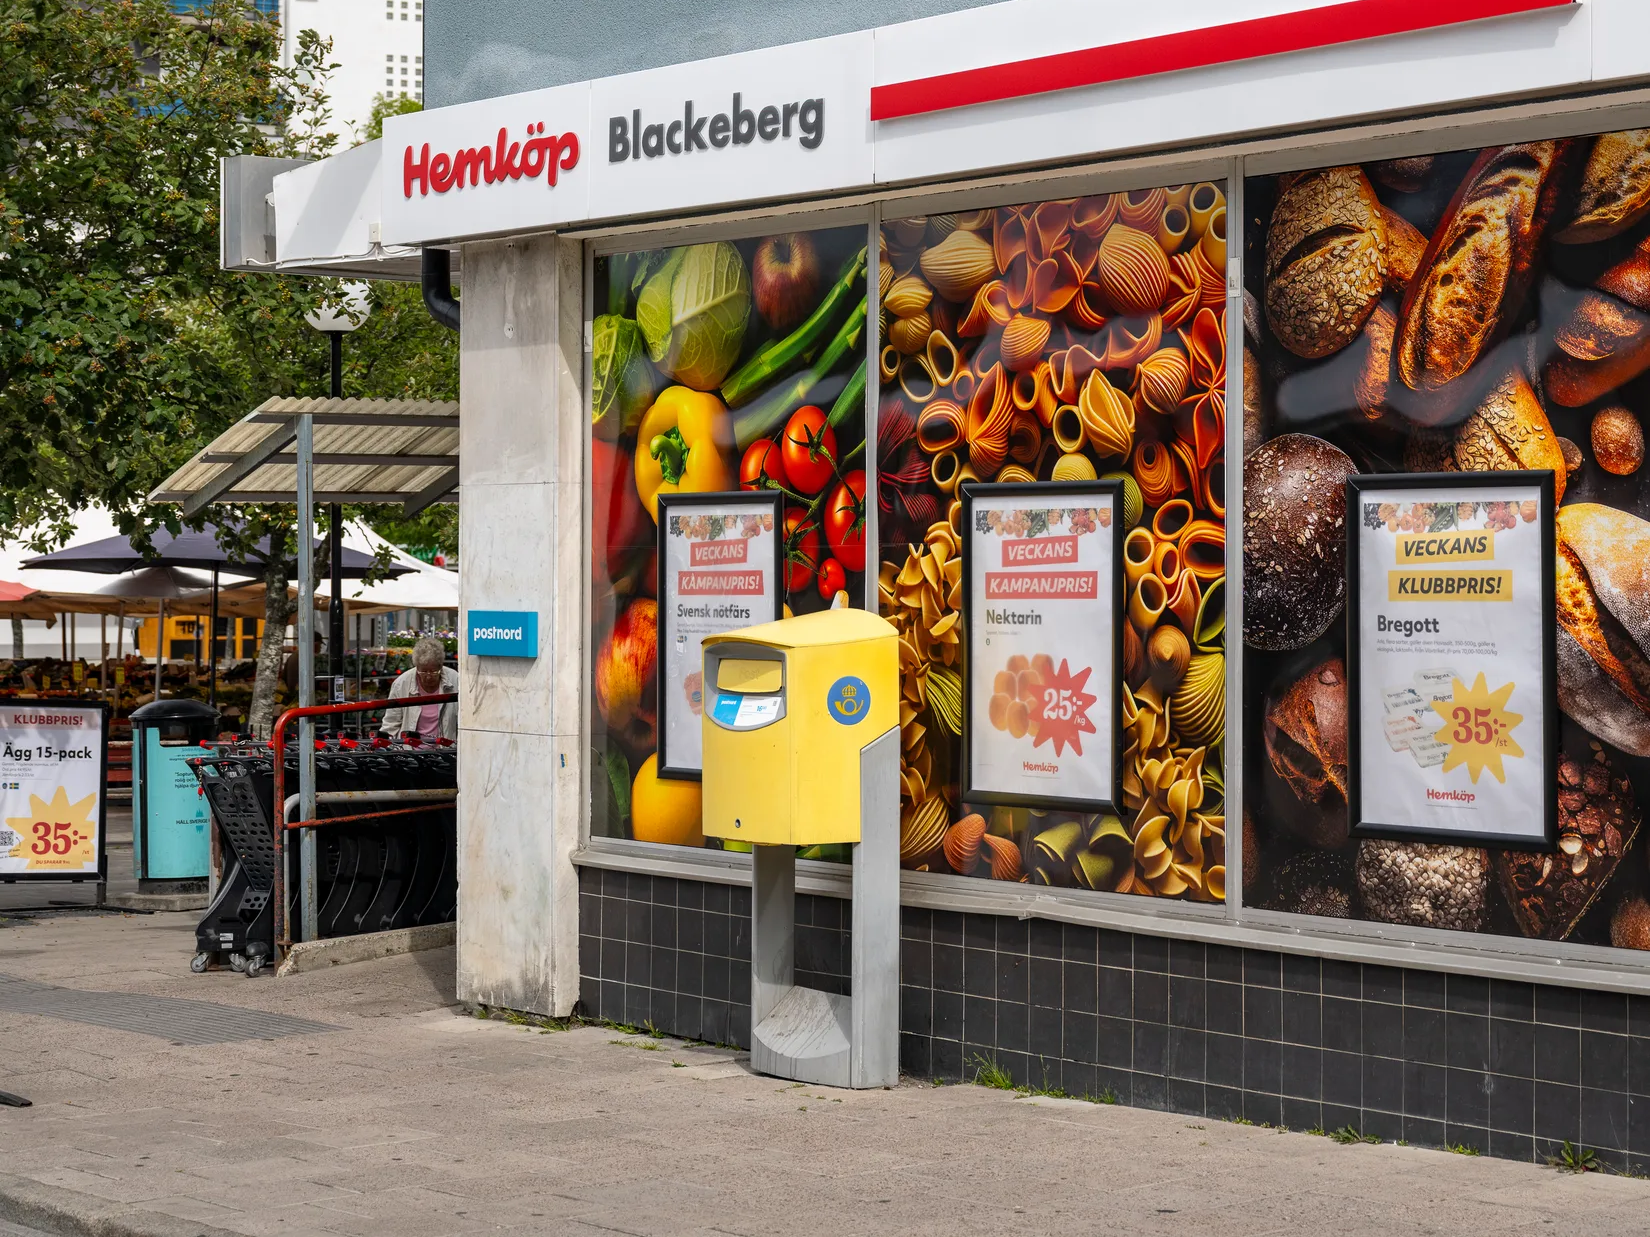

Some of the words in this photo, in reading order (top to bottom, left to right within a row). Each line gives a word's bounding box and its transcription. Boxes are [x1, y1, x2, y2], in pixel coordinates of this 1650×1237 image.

[403, 121, 581, 198] Hemköp
[608, 92, 826, 163] Blackeberg
[695, 544, 744, 561] VECKANS
[1008, 541, 1073, 560] VECKANS
[1404, 536, 1488, 557] VECKANS
[681, 575, 760, 590] KAMPANJPRIS!
[989, 577, 1093, 593] KAMPANJPRIS!
[1397, 576, 1502, 594] KLUBBPRIS!
[677, 603, 711, 618] Svensk
[713, 604, 750, 619] nötfärs
[986, 609, 1042, 625] Nektarin
[473, 626, 522, 642] postnord
[1377, 614, 1440, 638] Bregott
[1042, 688, 1083, 720] 25:-
[13, 714, 83, 725] KLUBBPRIS!
[1073, 715, 1086, 726] /kg
[1452, 706, 1507, 745] 35:-
[1495, 737, 1508, 748] /st
[2, 742, 32, 761] Ägg
[36, 746, 92, 762] 15-pack
[1023, 761, 1059, 774] Hemköp
[1426, 788, 1476, 803] Hemköp
[31, 821, 88, 855] 35:-
